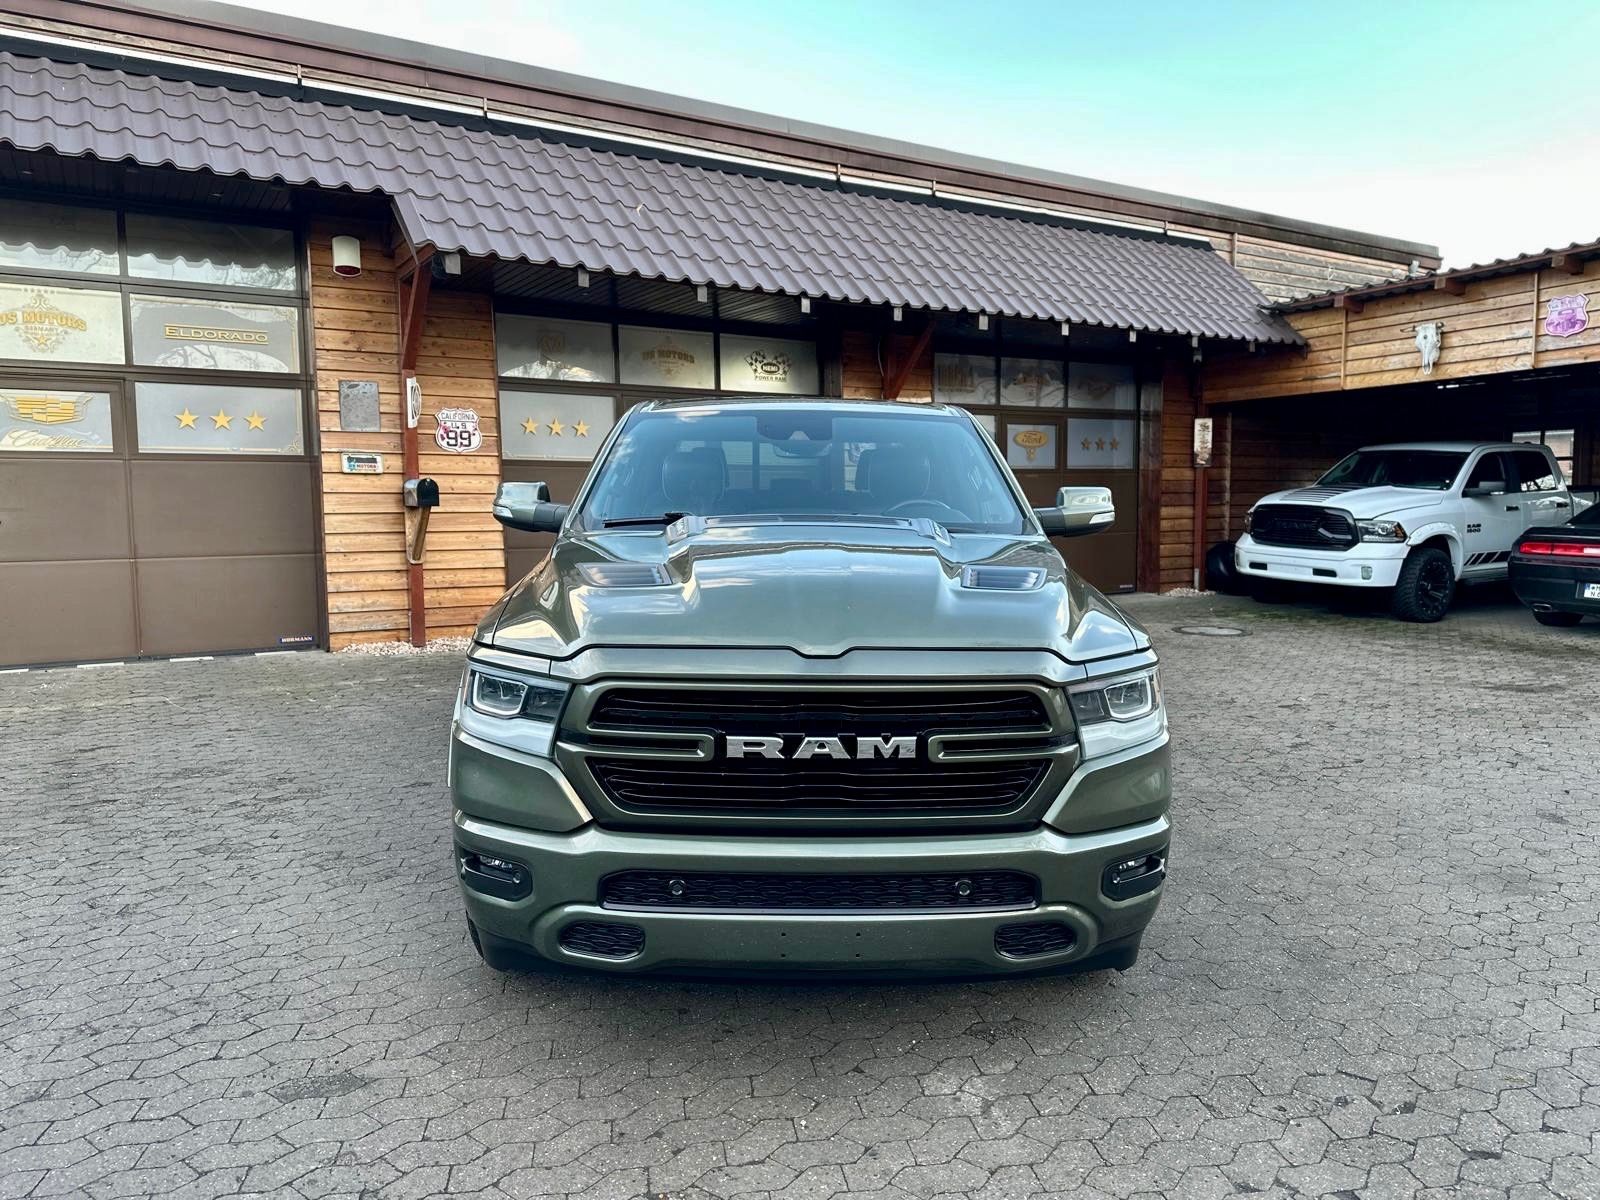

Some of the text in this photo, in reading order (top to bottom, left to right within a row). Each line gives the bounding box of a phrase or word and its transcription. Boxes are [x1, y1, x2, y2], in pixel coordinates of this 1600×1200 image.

[23, 311, 87, 331] MOTORS
[165, 326, 268, 342] ELDORADO
[657, 349, 695, 364] MOTORS
[441, 412, 476, 421] CALIFORNIA
[446, 430, 471, 447] 99
[726, 736, 918, 759] RAM
